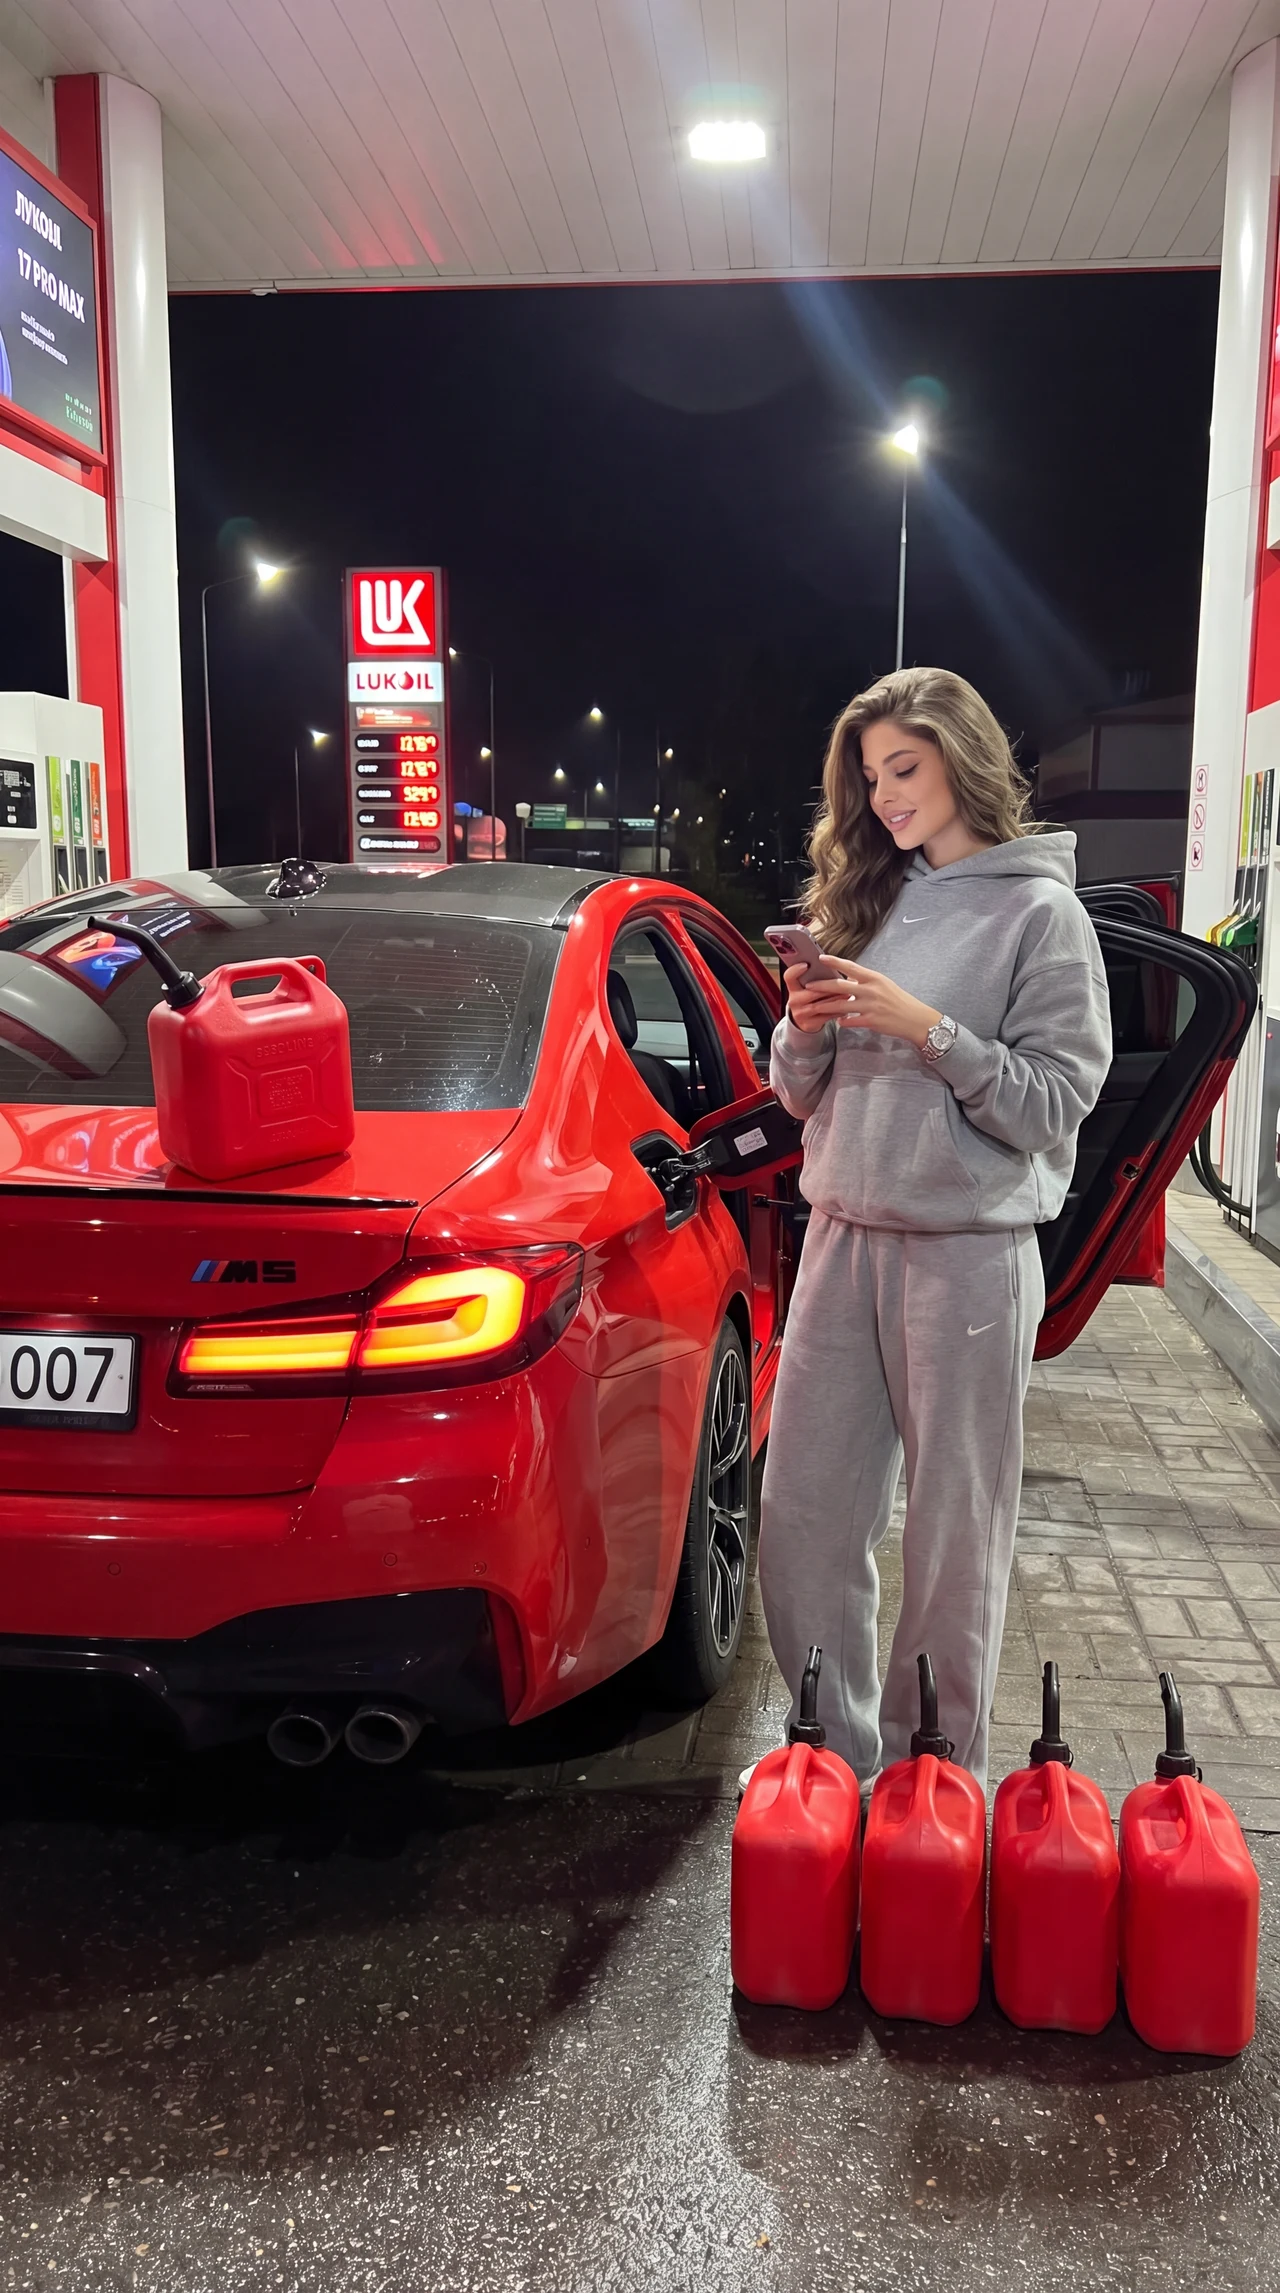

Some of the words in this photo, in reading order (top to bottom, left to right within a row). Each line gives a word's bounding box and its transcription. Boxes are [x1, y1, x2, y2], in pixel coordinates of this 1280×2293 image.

[18, 248, 31, 280] 17
[33, 260, 57, 301] PRO
[59, 280, 85, 323] MAX
[356, 671, 434, 690] LUKOIL
[221, 1261, 296, 1283] M5
[10, 1345, 114, 1403] 007
